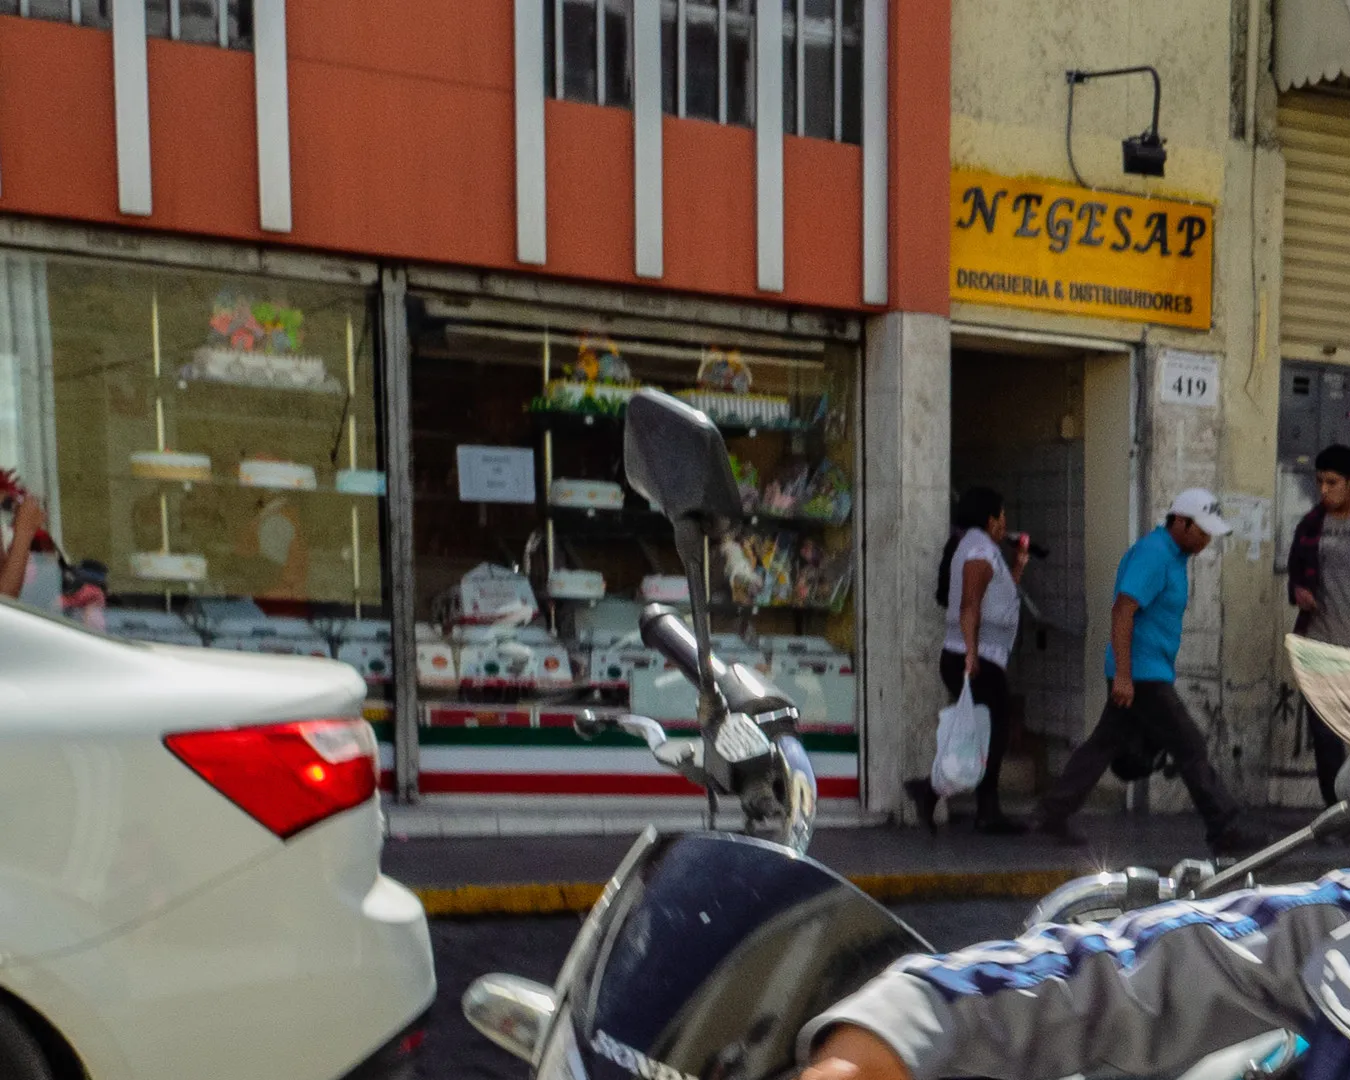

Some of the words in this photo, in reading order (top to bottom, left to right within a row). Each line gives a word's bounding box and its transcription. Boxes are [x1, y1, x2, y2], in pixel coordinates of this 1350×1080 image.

[956, 185, 1207, 258] NEGESAP
[957, 268, 1050, 298] DROGUERIA
[1053, 280, 1065, 300] &
[1069, 281, 1194, 314] DISTRIBUIDORES
[1172, 375, 1207, 397] 419
